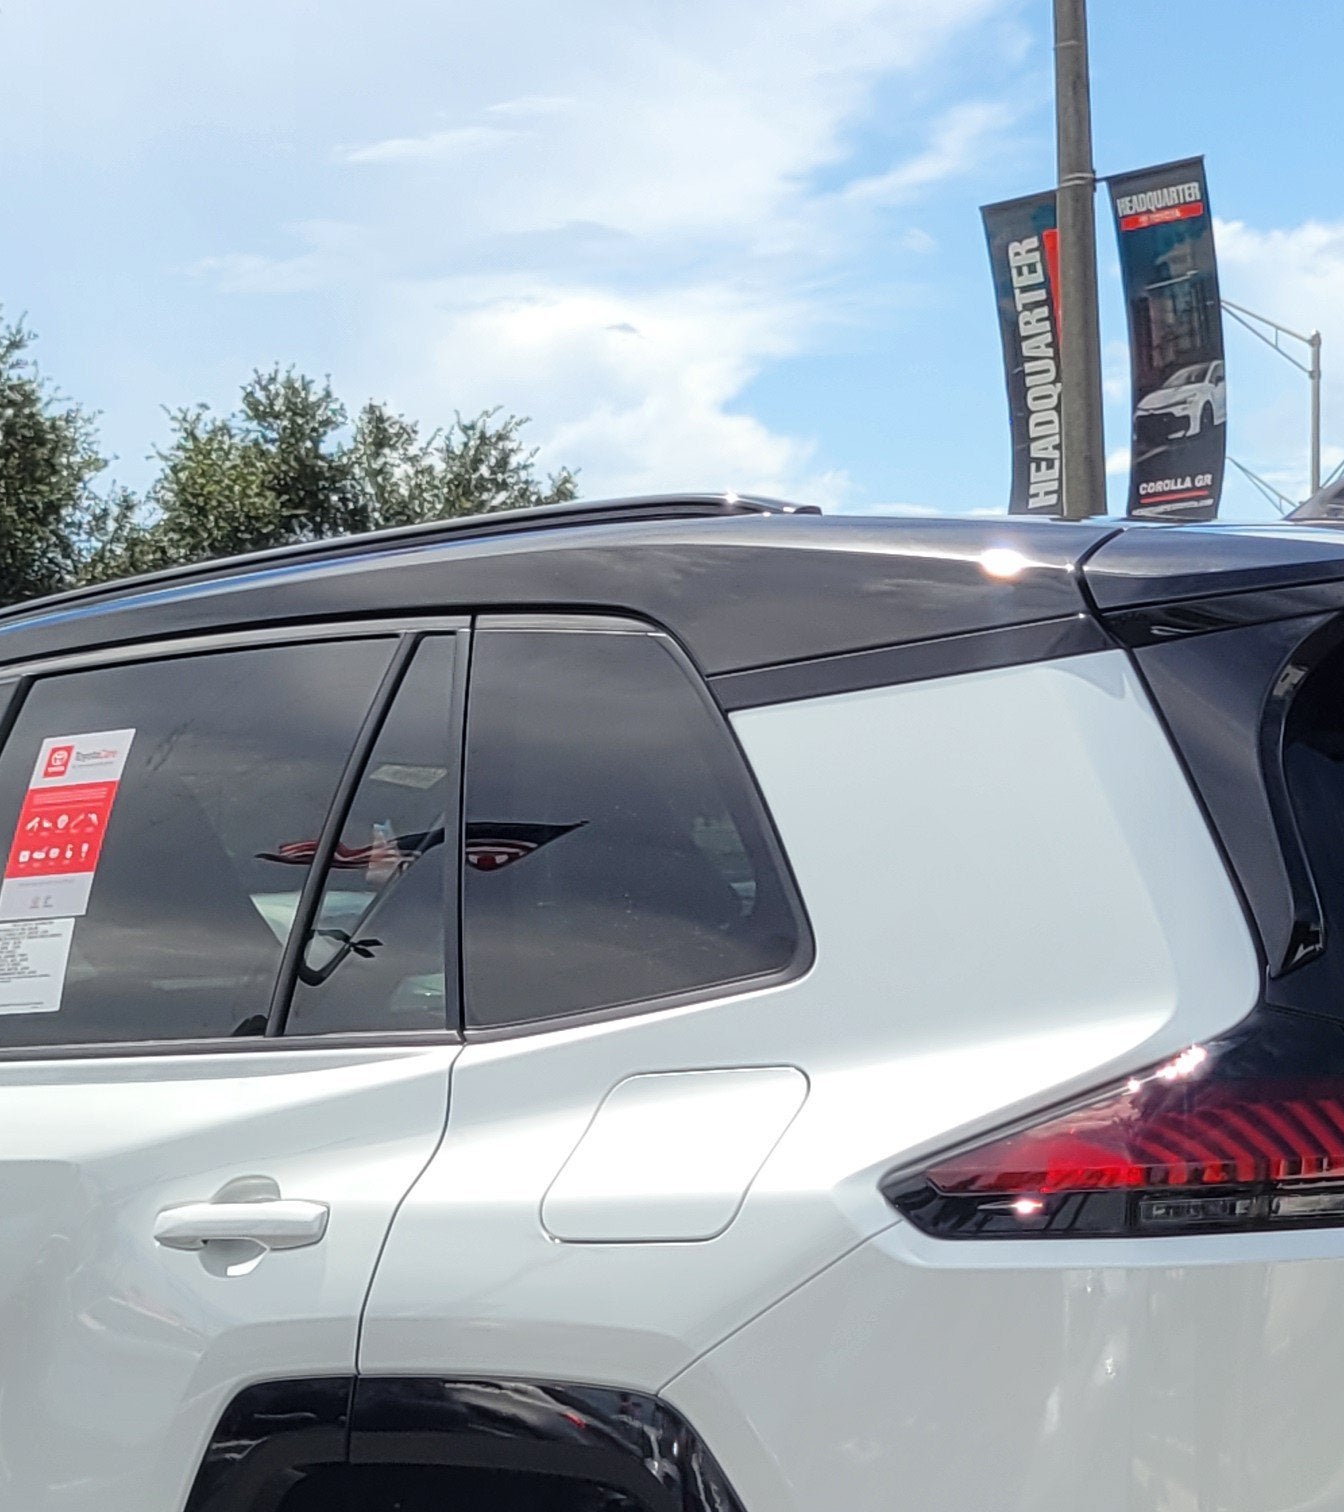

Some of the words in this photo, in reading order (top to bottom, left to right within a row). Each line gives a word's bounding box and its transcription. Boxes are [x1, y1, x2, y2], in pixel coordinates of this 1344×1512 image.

[1117, 181, 1201, 217] HEADQUARTER
[1008, 235, 1063, 510] HEADQUARTER
[1139, 476, 1192, 495] COROLLA
[1195, 474, 1213, 487] GR
